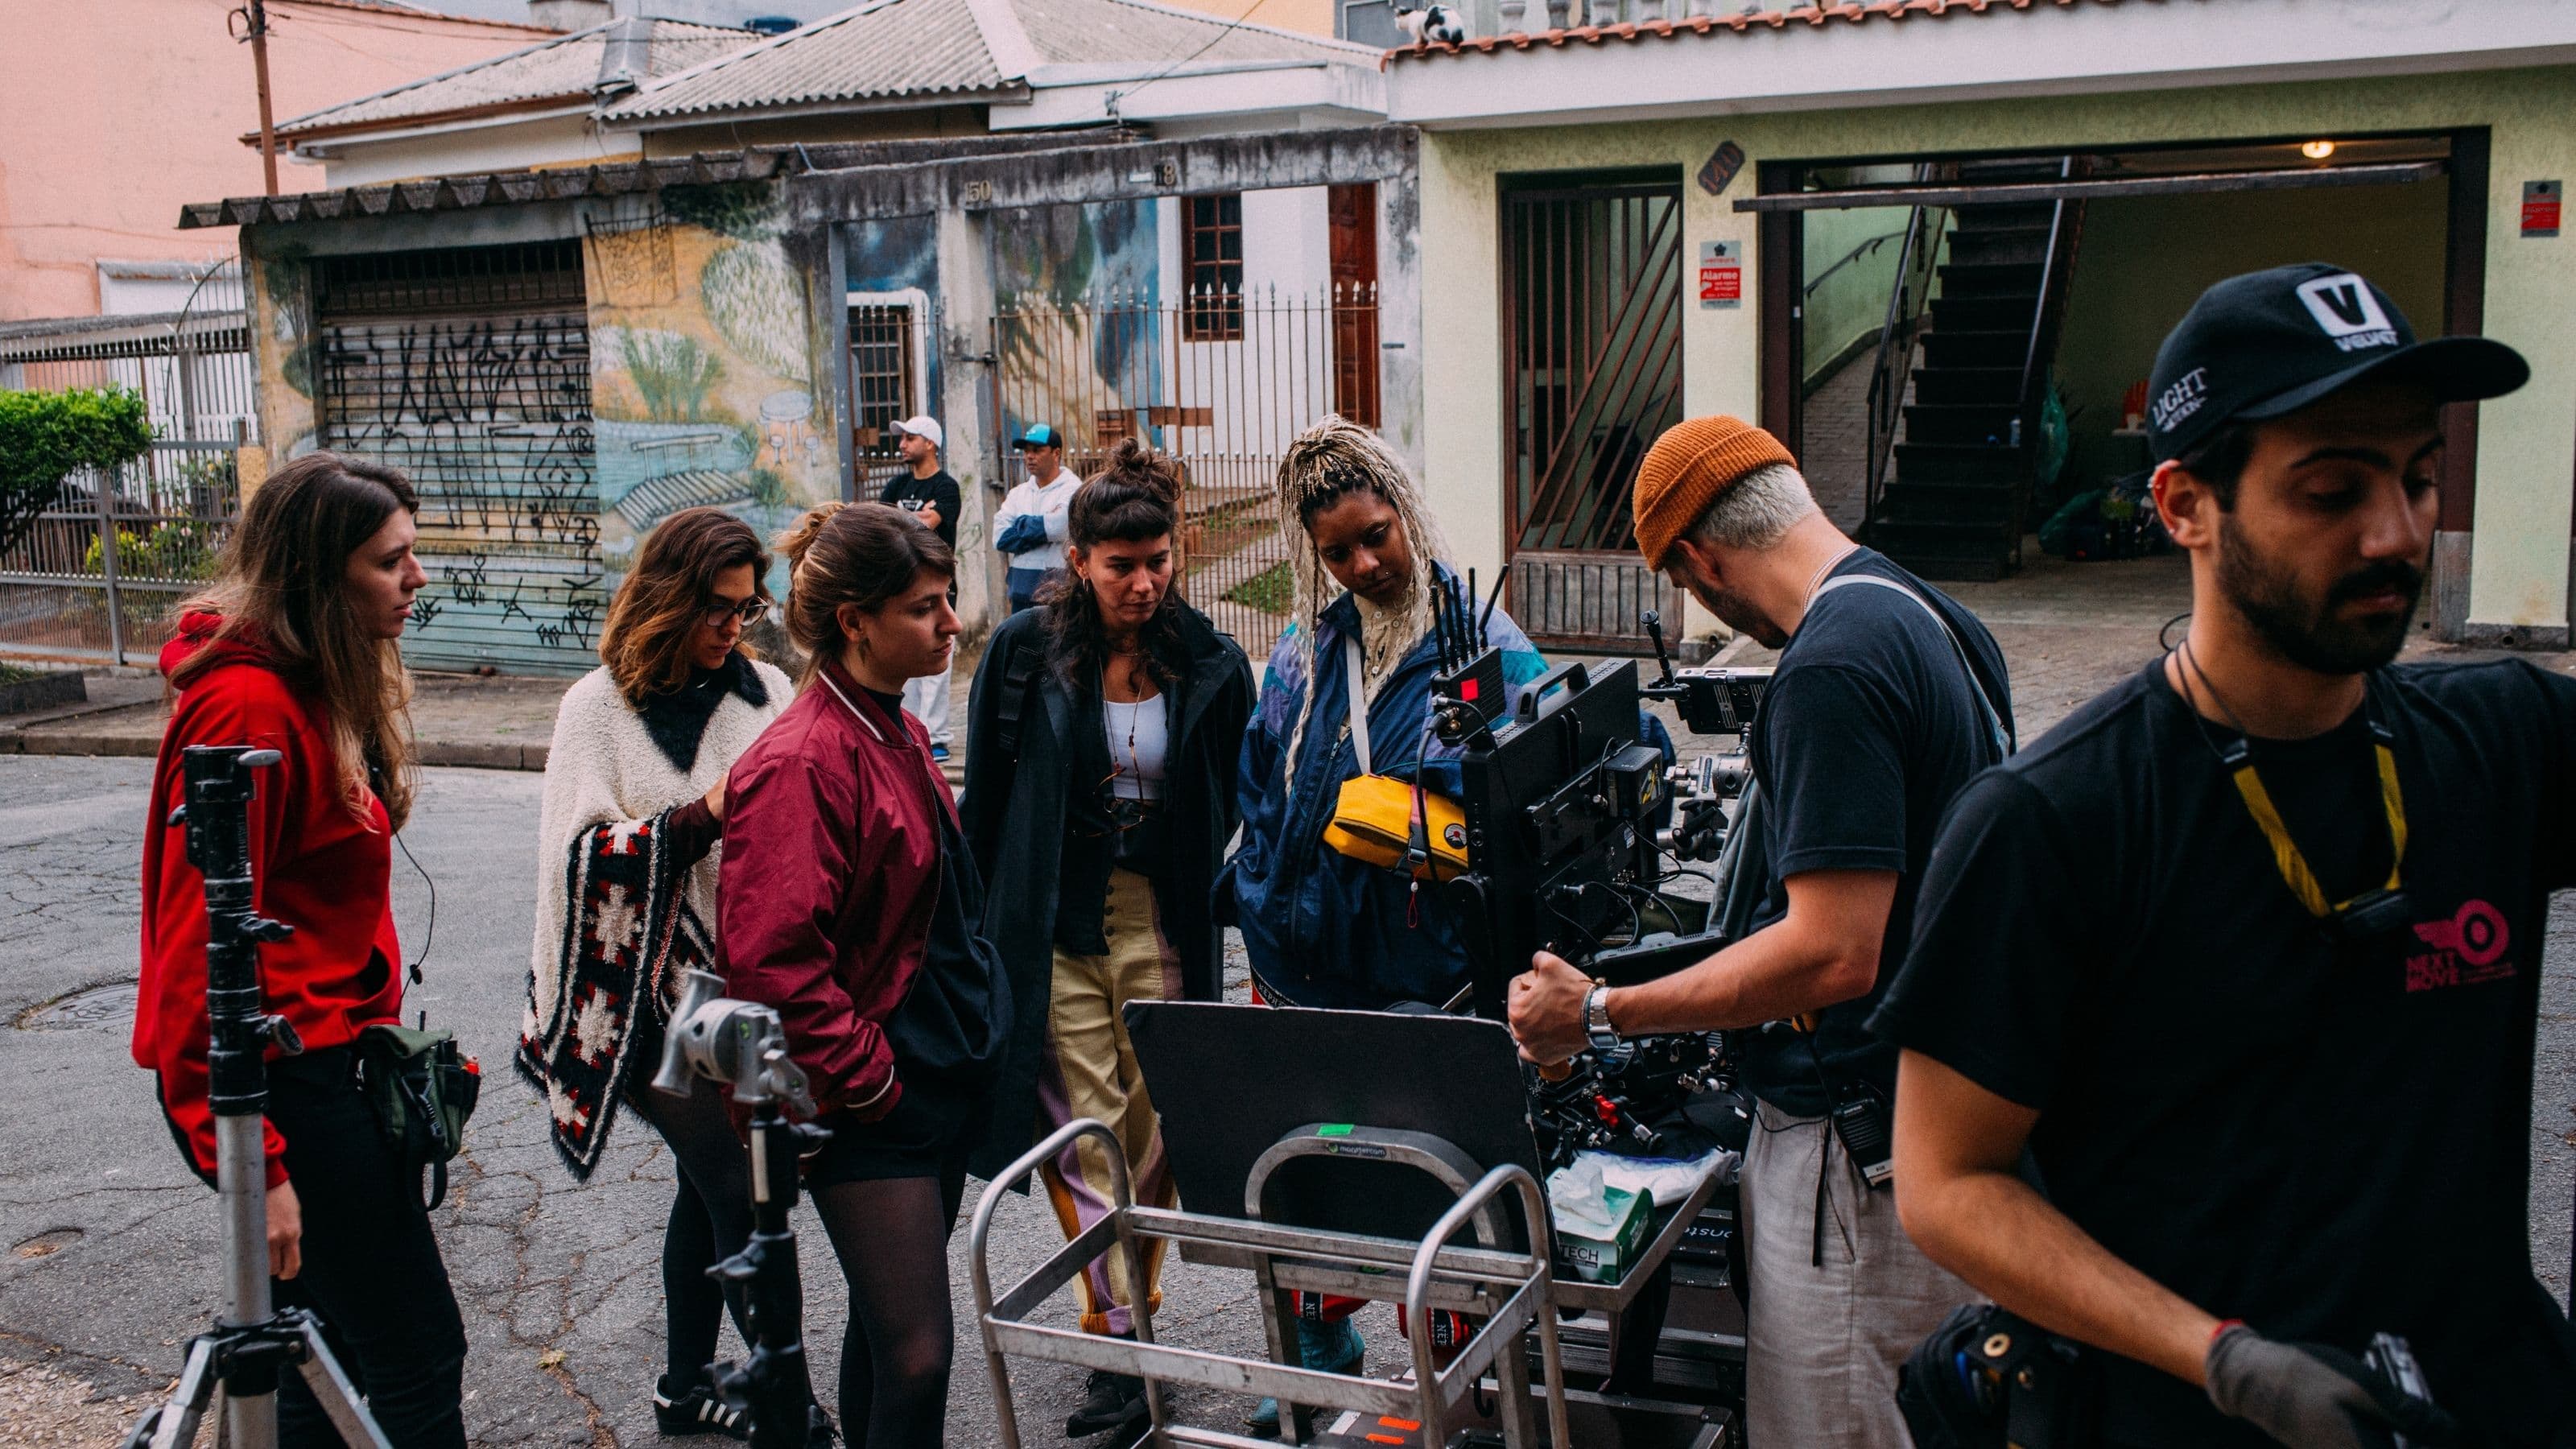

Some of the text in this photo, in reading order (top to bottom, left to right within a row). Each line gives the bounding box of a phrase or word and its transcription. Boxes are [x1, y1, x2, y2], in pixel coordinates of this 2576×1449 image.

[1702, 270, 1739, 281] Alarme
[2313, 283, 2367, 327] V
[2153, 366, 2207, 426] LIGHT
[2406, 968, 2460, 993] MOVE
[1559, 1244, 1599, 1261] TECH
